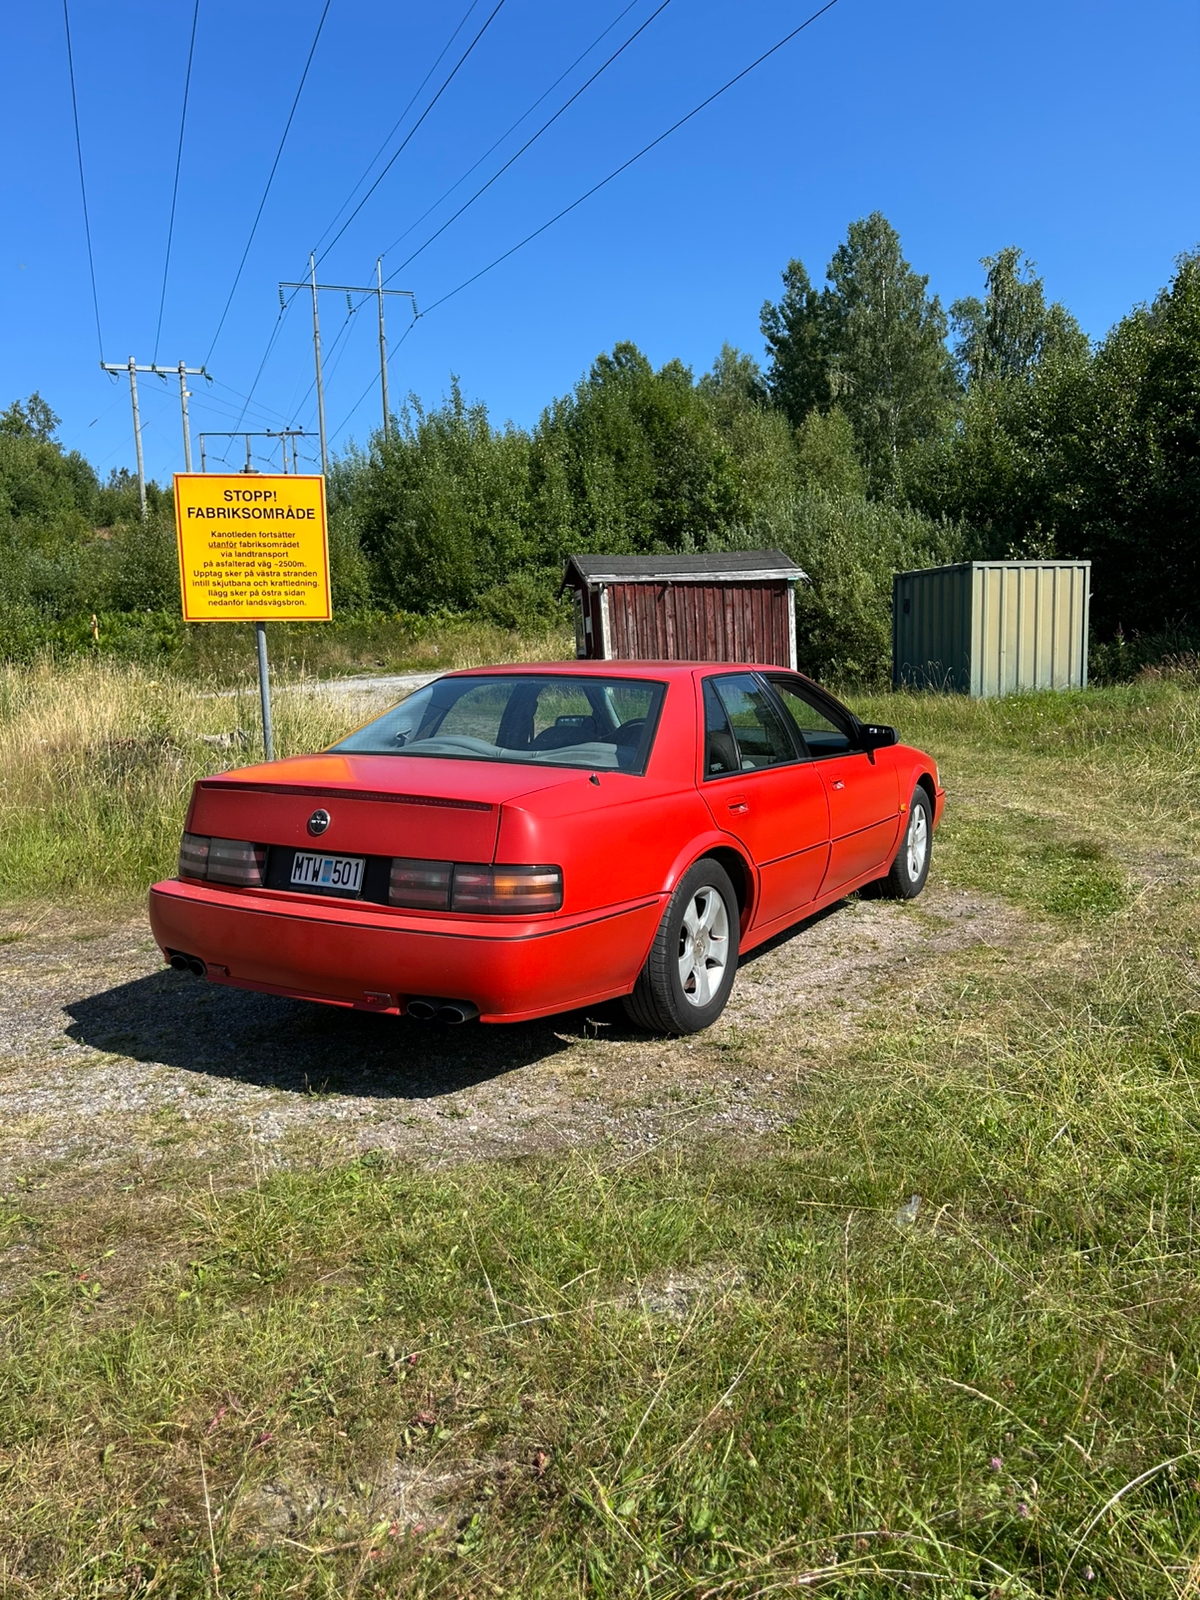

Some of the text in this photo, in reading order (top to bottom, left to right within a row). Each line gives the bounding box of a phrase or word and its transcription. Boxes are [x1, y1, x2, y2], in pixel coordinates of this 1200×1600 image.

[223, 489, 277, 502] STOPP!
[187, 504, 316, 520] FABRIKSOMRÅDE
[211, 530, 296, 539] Kanotleden fortsätter
[208, 540, 300, 549] utanför fabriksområdet
[234, 551, 289, 559] landtransport
[203, 560, 214, 569] på
[215, 560, 255, 568] asfalterad
[257, 560, 272, 569] väg
[193, 570, 223, 578] Upptag
[244, 570, 255, 578] på
[192, 579, 320, 588] intill skjutbana och kraftledning.
[229, 589, 247, 597] sker
[249, 589, 260, 598] på
[261, 589, 282, 597] östra
[284, 589, 306, 597] sidan
[246, 599, 307, 607] landsvägsbron.
[292, 855, 360, 887] MTW 501
